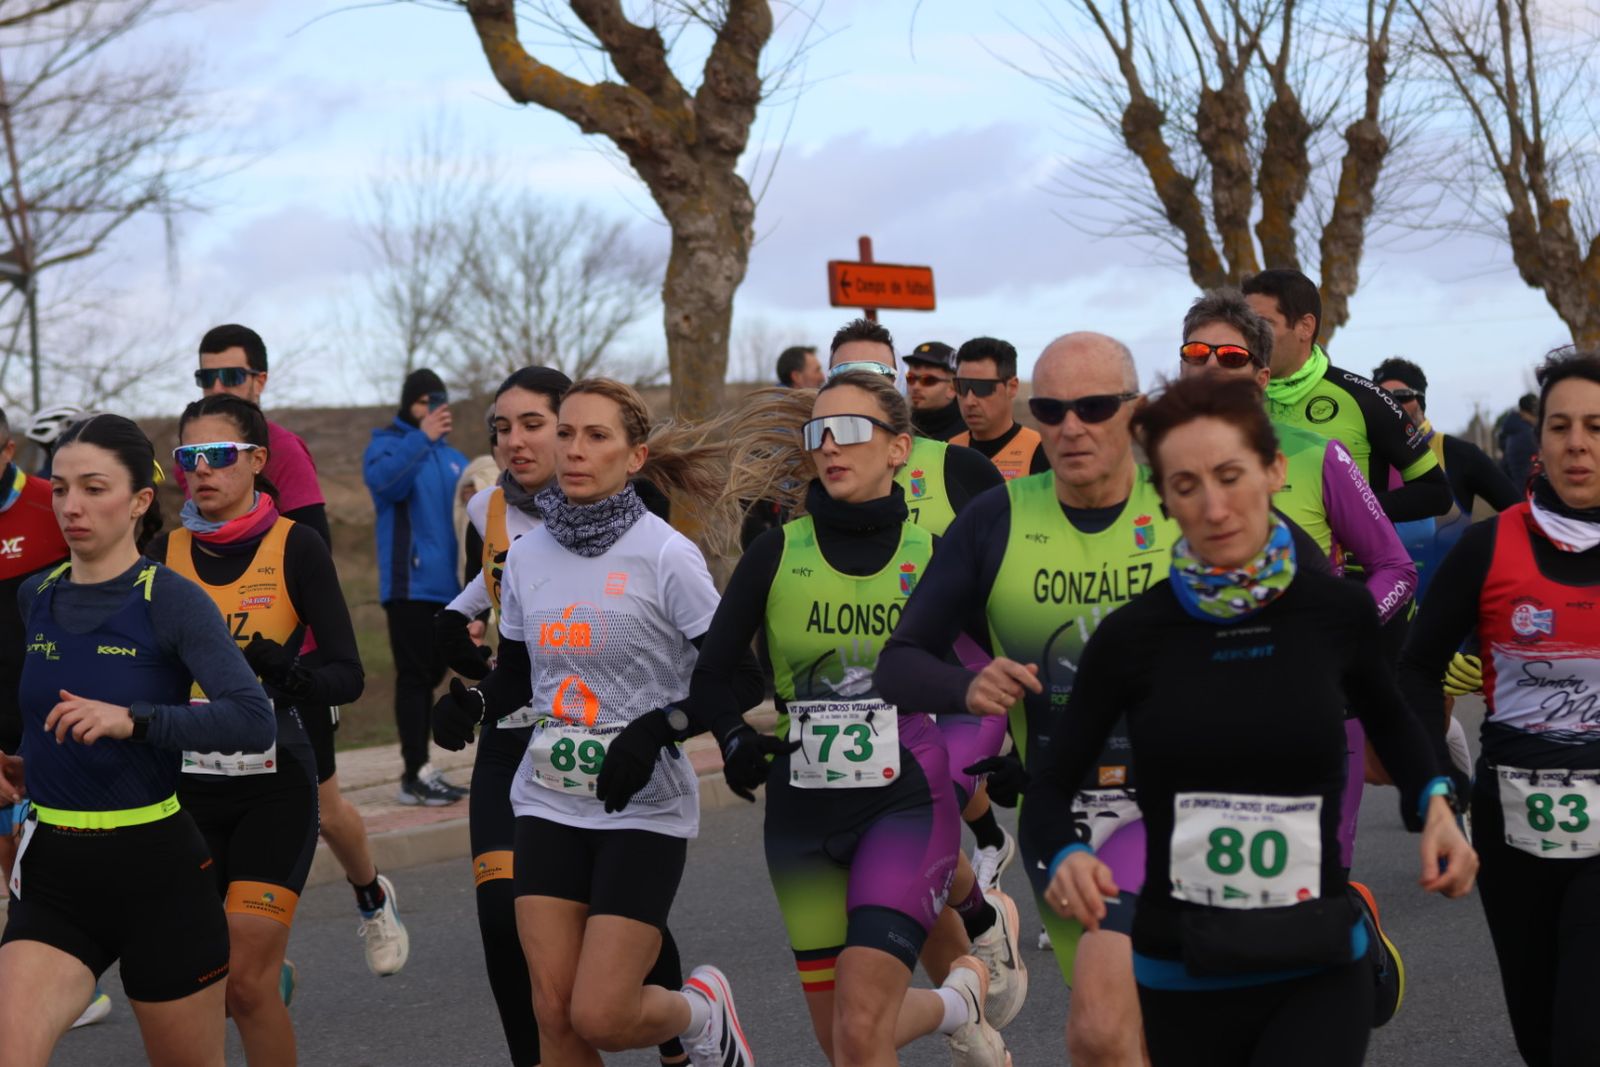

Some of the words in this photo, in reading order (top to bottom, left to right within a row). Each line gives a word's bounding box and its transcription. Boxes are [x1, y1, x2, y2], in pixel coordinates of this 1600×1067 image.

[1343, 373, 1403, 420] CARBAJOSA
[1033, 562, 1153, 605] GONZÁLEZ
[806, 600, 903, 637] ALONSO
[828, 703, 850, 713] CROSS
[550, 737, 606, 776] 89
[812, 723, 874, 763] 73
[1525, 792, 1590, 834] 83
[1206, 827, 1288, 879] 80
